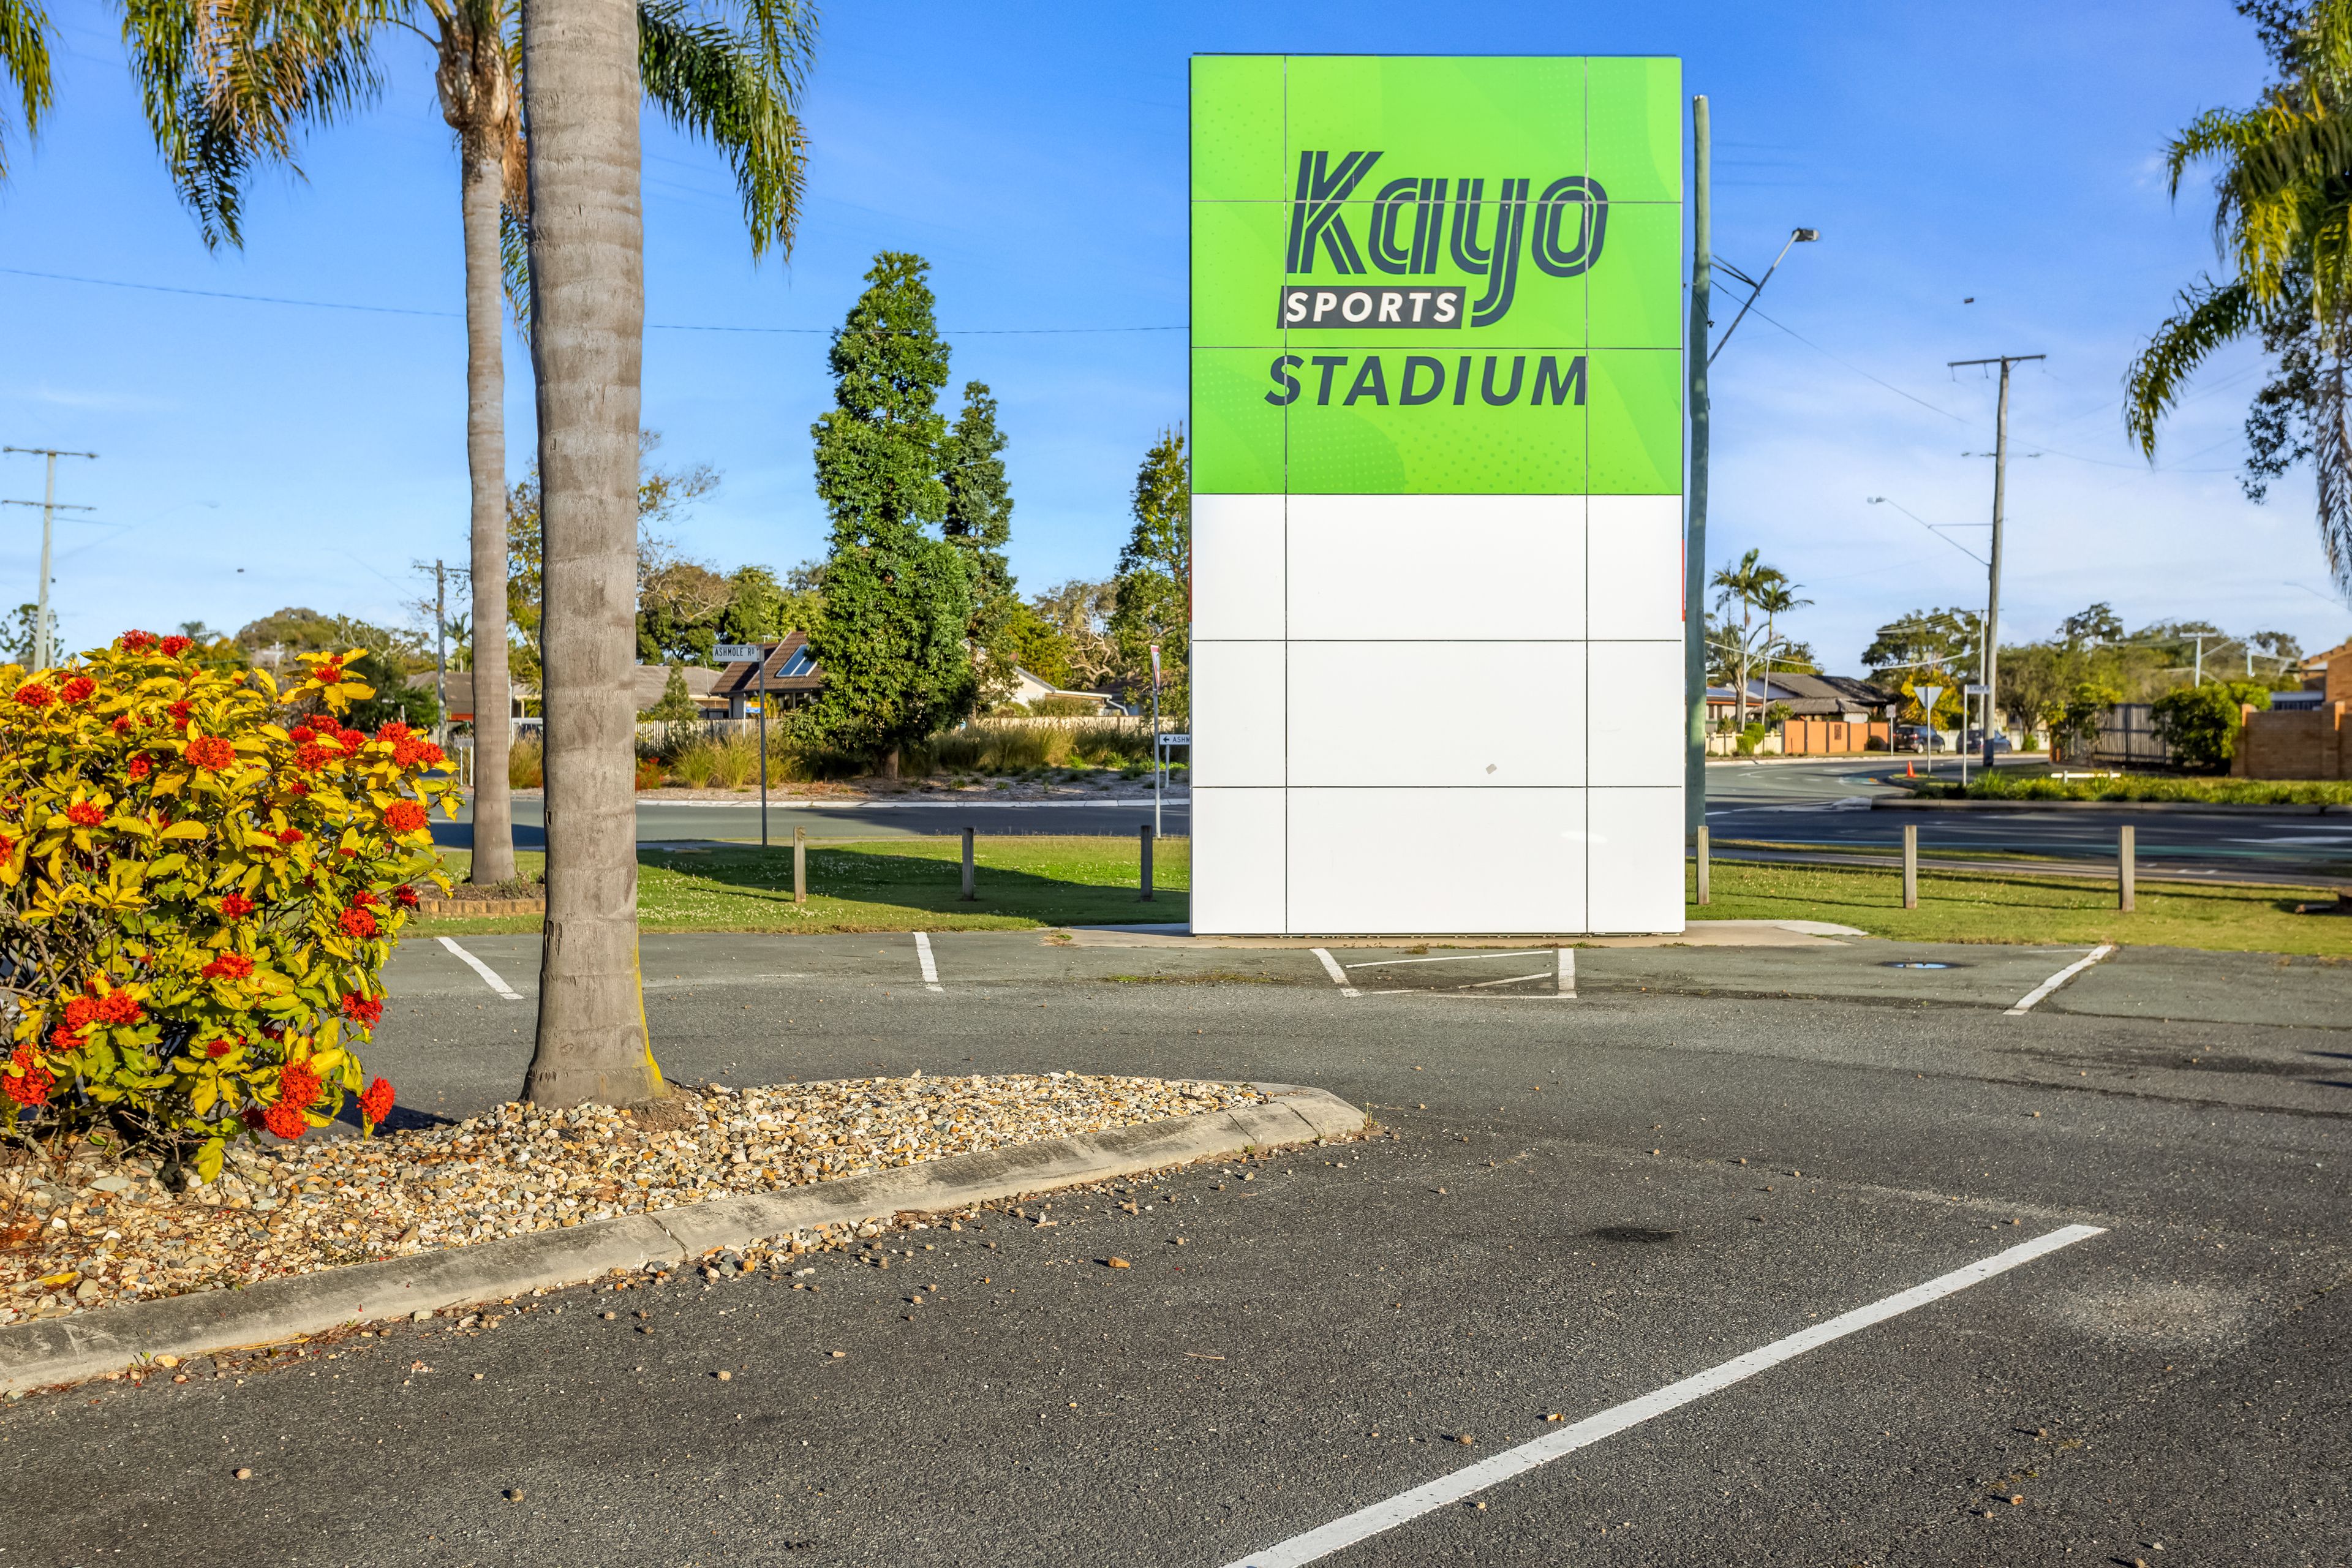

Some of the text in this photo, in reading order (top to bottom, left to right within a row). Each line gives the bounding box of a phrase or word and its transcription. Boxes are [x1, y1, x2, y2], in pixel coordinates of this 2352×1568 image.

[1286, 151, 1608, 327] Kayo
[1286, 292, 1457, 322] SPORTS
[1265, 355, 1586, 406] STADIUM
[715, 647, 743, 657] ASHMOLE
